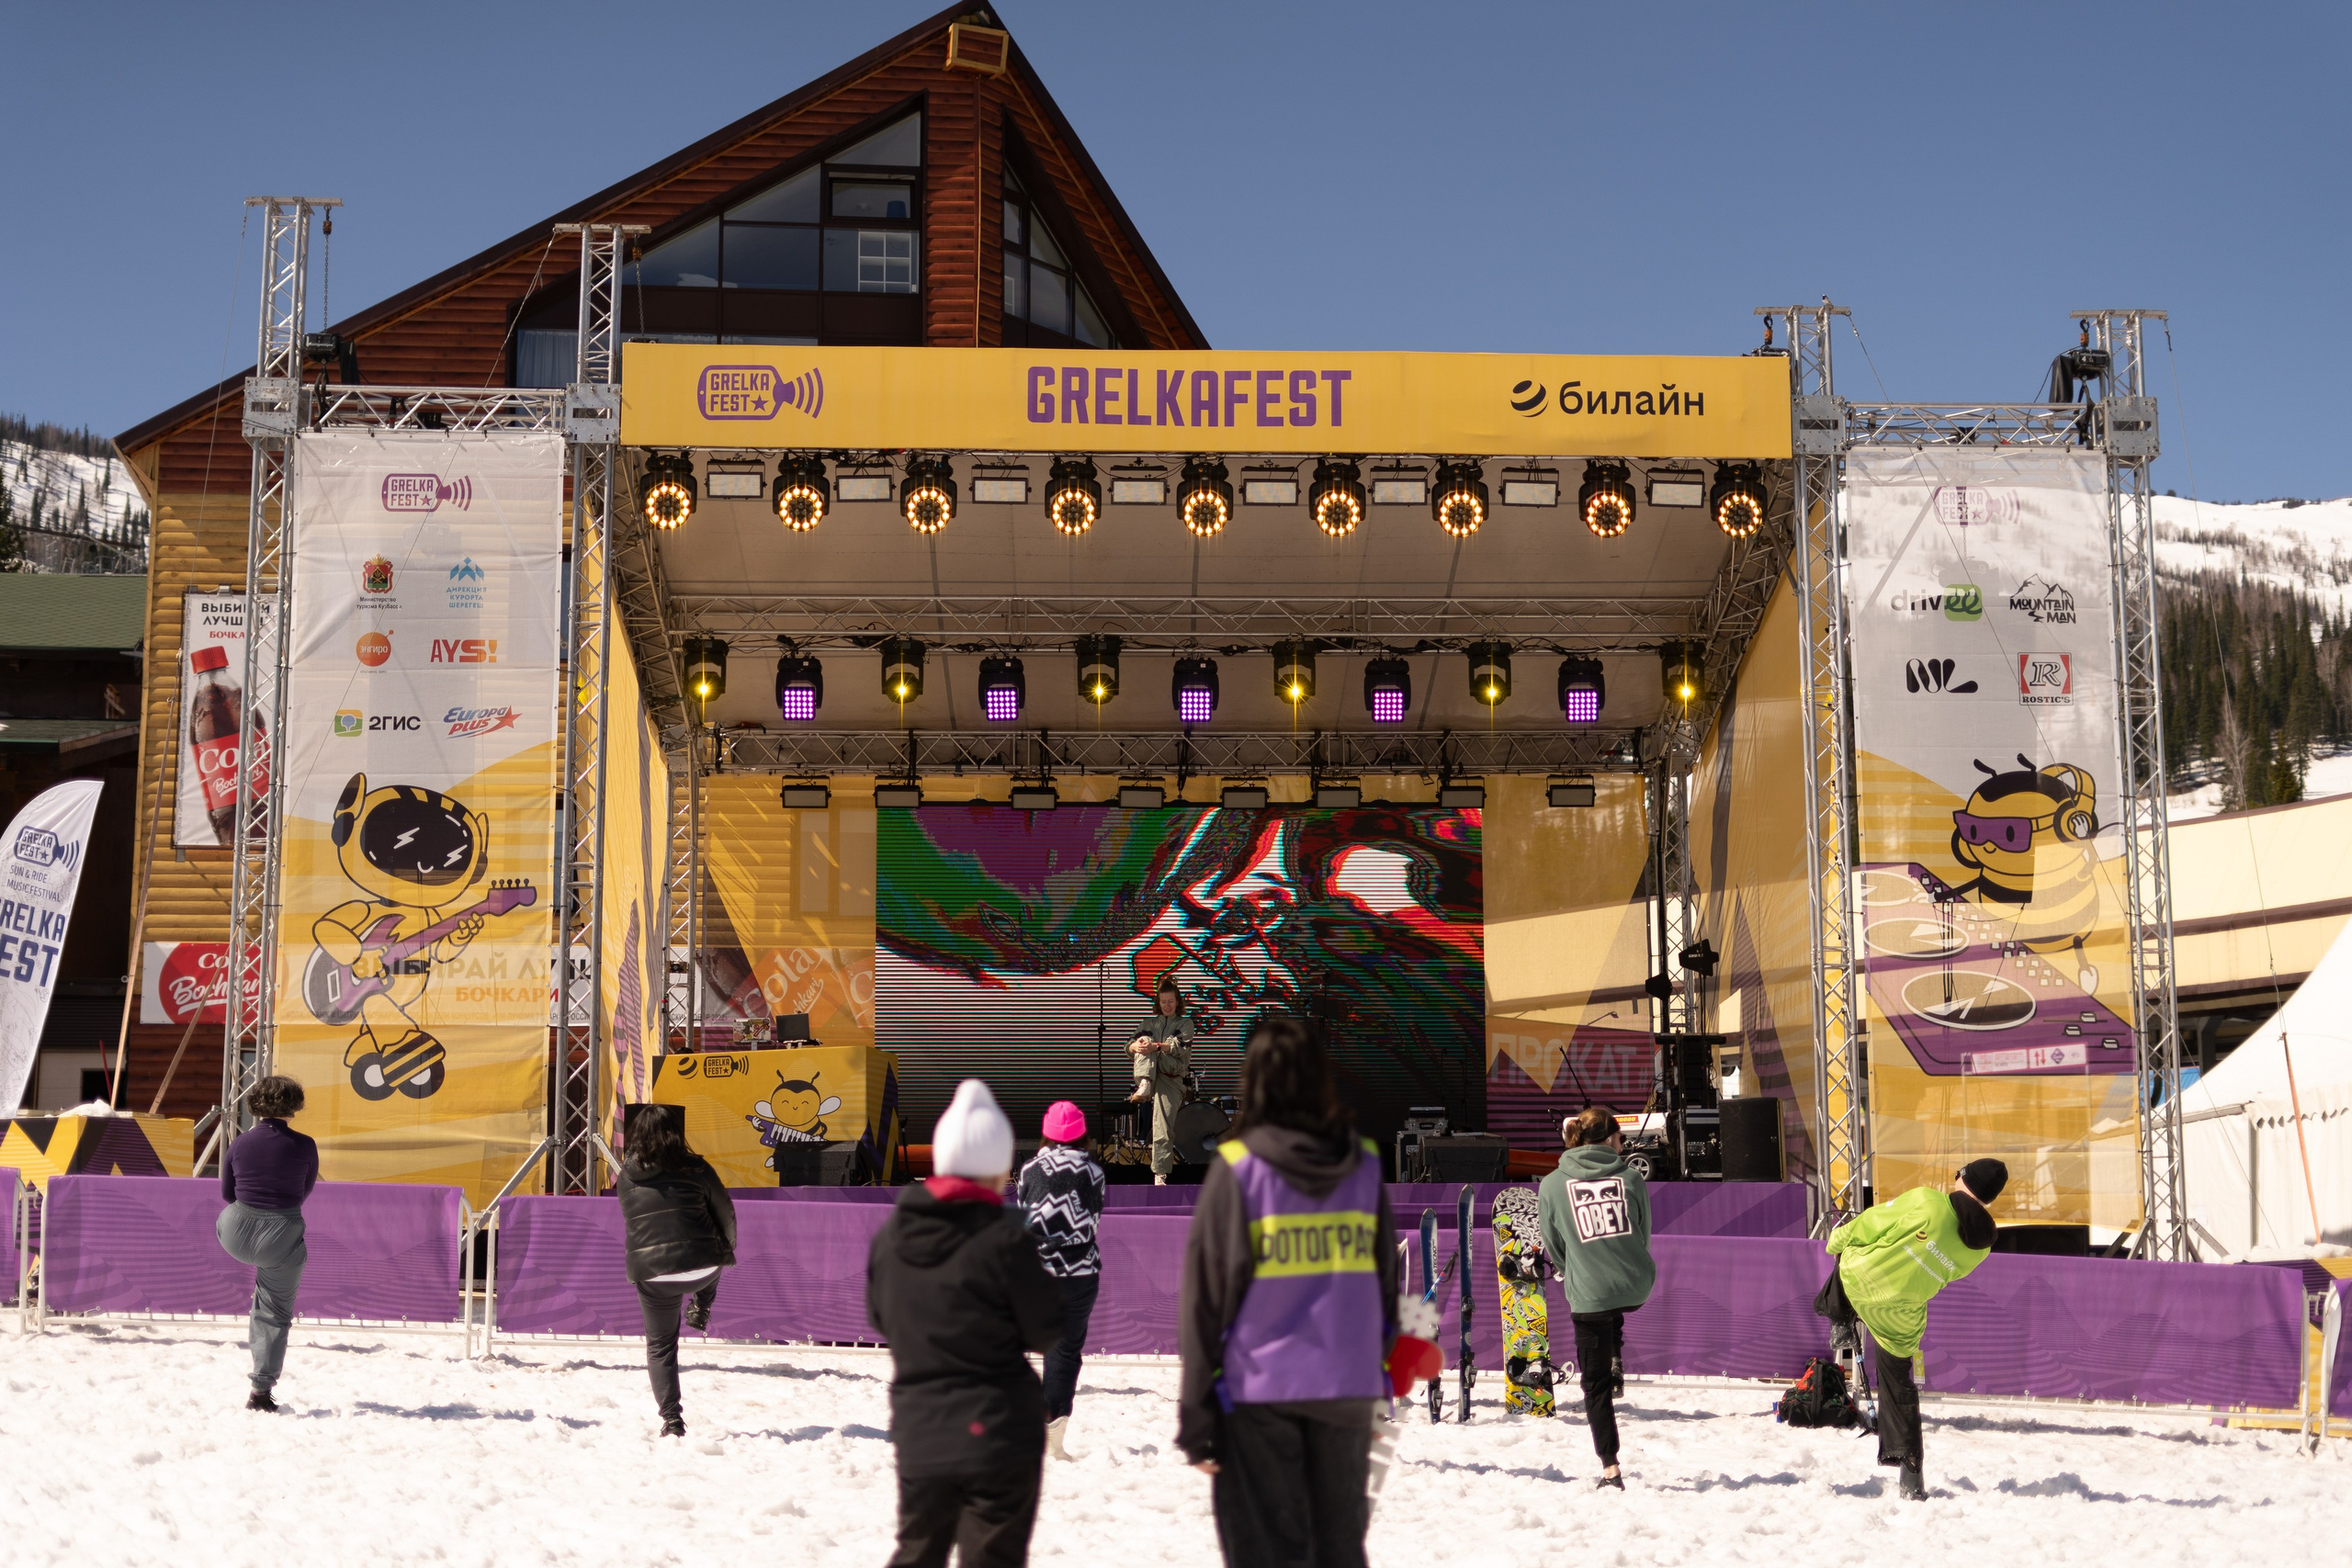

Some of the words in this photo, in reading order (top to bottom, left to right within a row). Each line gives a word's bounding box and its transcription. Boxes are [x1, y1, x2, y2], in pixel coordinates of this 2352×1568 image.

[710, 372, 770, 391] GRELKA
[710, 394, 749, 412] FEST
[1027, 366, 1351, 427] GRELKAFEST
[1560, 381, 1705, 416] билайн
[391, 479, 434, 492] GRELKA
[390, 493, 419, 506] FEST
[1942, 492, 1984, 505] GRELKA
[1942, 507, 1968, 520] FEST
[1891, 589, 1982, 615] drivee
[2010, 598, 2075, 611] MOUNTAIN
[2046, 612, 2076, 624] MAN
[360, 646, 389, 656] энгиро
[430, 638, 498, 663] AYS!
[2022, 695, 2071, 704] ROSTIC'S
[368, 716, 421, 731] 2ГИС
[199, 740, 267, 774] Coa
[22, 831, 53, 849] GRELKA
[19, 843, 40, 859] FEST
[10, 865, 25, 877] SUN
[25, 869, 30, 879] &
[31, 871, 48, 884] RIDE
[7, 879, 29, 894] MUSIC
[29, 886, 61, 902] FESTIVAL
[0, 898, 65, 942] RELKA
[743, 947, 815, 1019] Cola
[456, 987, 559, 1002] БОЧКАРИ
[707, 1058, 729, 1068] GRELKA
[707, 1067, 723, 1076] FEST
[1491, 1032, 1636, 1093] ПРОКАТ
[1038, 1158, 1054, 1176] FILA
[1577, 1201, 1627, 1238] OBEY
[1258, 1224, 1374, 1265] ФОТОГРА
